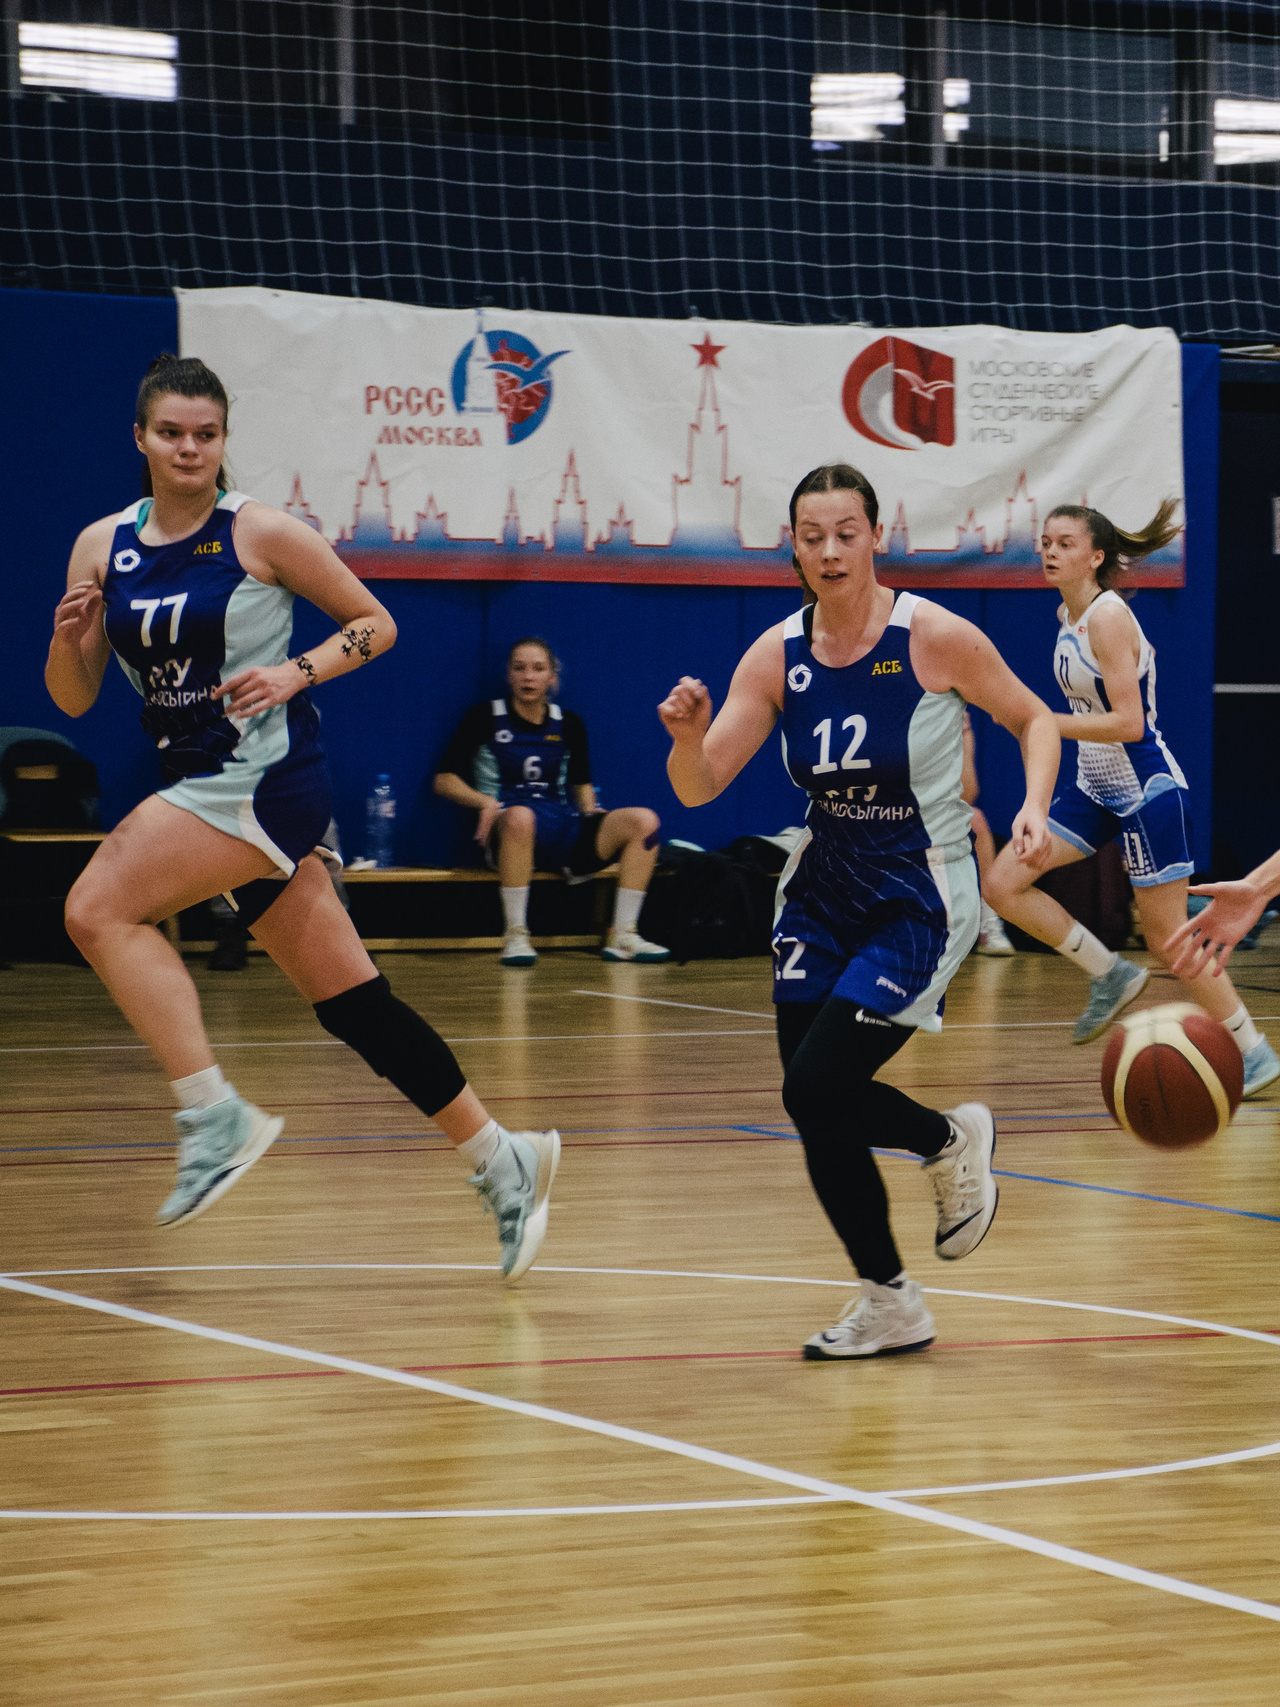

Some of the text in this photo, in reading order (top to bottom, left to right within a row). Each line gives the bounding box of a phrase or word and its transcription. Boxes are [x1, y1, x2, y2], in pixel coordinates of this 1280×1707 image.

[968, 361, 1096, 378] МОСКОВСКИЕ
[365, 385, 445, 416] РССС
[969, 382, 1100, 400] СТУДЕНЧЕСКИЕ
[969, 405, 1087, 422] СПОРТИВНЫЕ
[376, 426, 483, 447] МОСКВА
[969, 427, 1015, 443] ИГРЫ
[130, 592, 188, 647] 77
[1059, 654, 1074, 691] 11
[812, 714, 872, 775] 12
[523, 755, 542, 780] 6
[1123, 832, 1145, 871] 11
